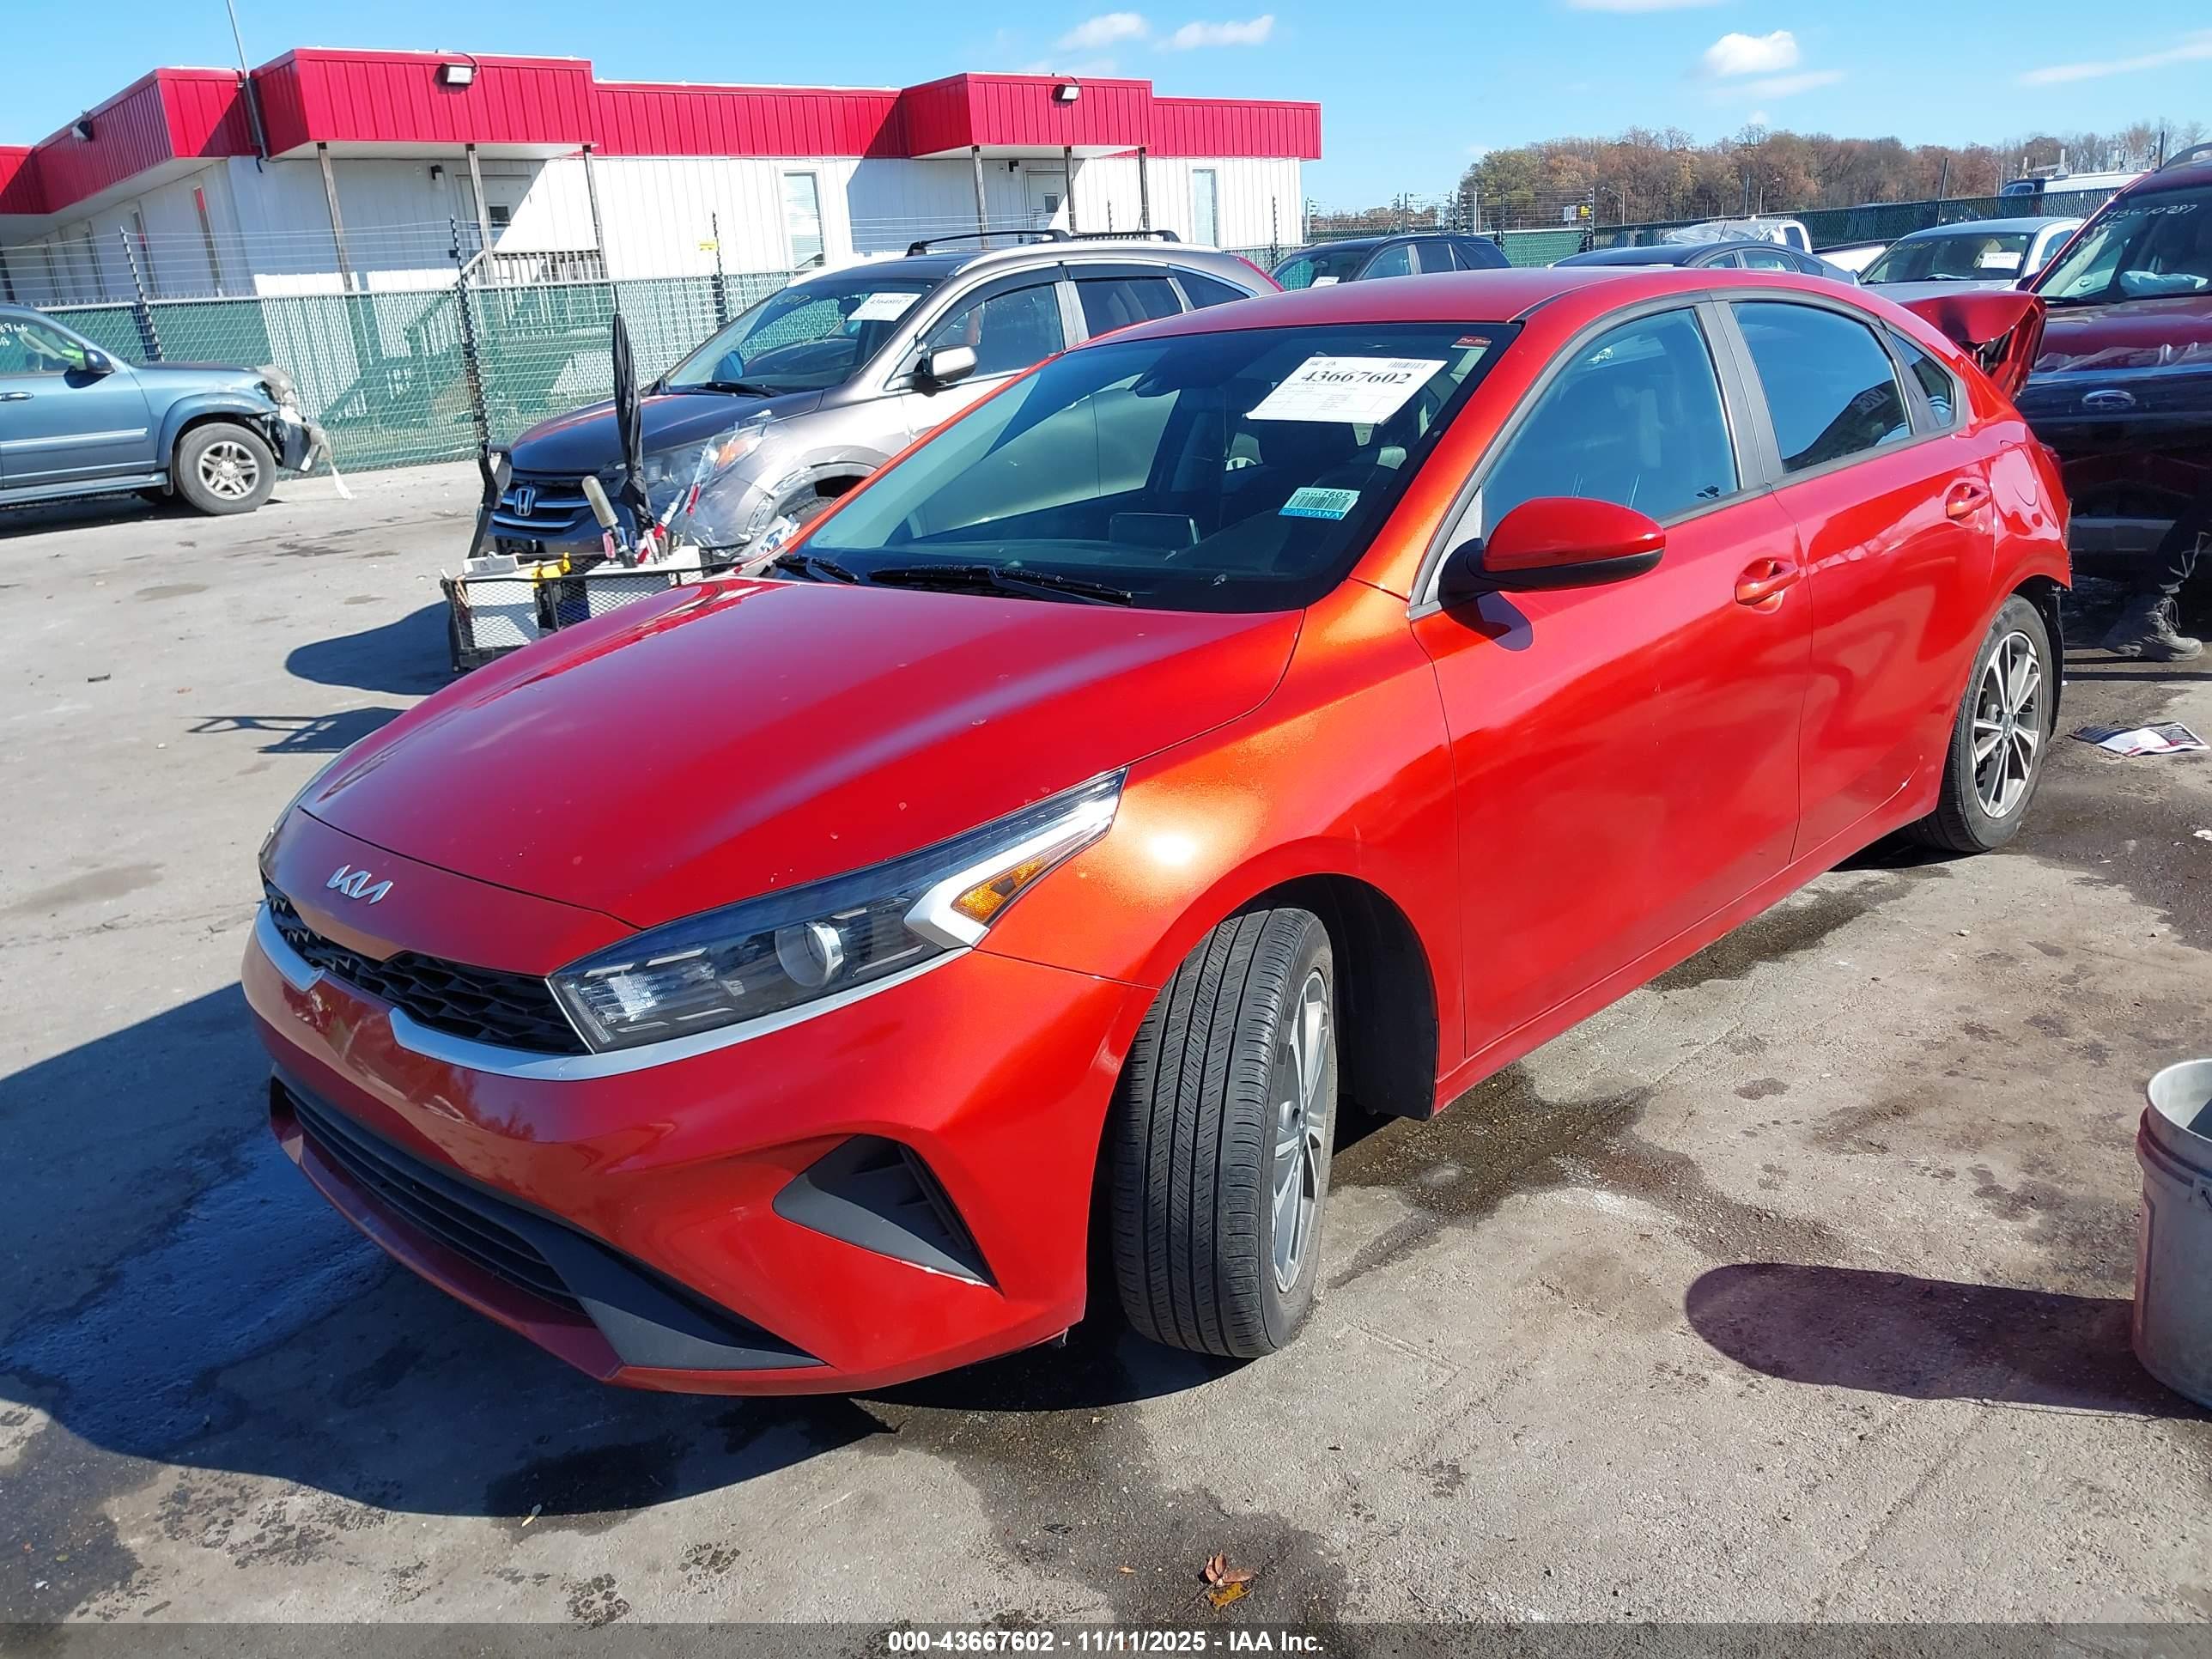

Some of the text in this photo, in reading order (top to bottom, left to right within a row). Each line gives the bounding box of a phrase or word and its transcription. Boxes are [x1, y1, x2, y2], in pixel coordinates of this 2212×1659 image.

[1301, 370, 1413, 385] 43667602
[1280, 507, 1340, 519] CARVANA
[326, 864, 393, 905] KIA
